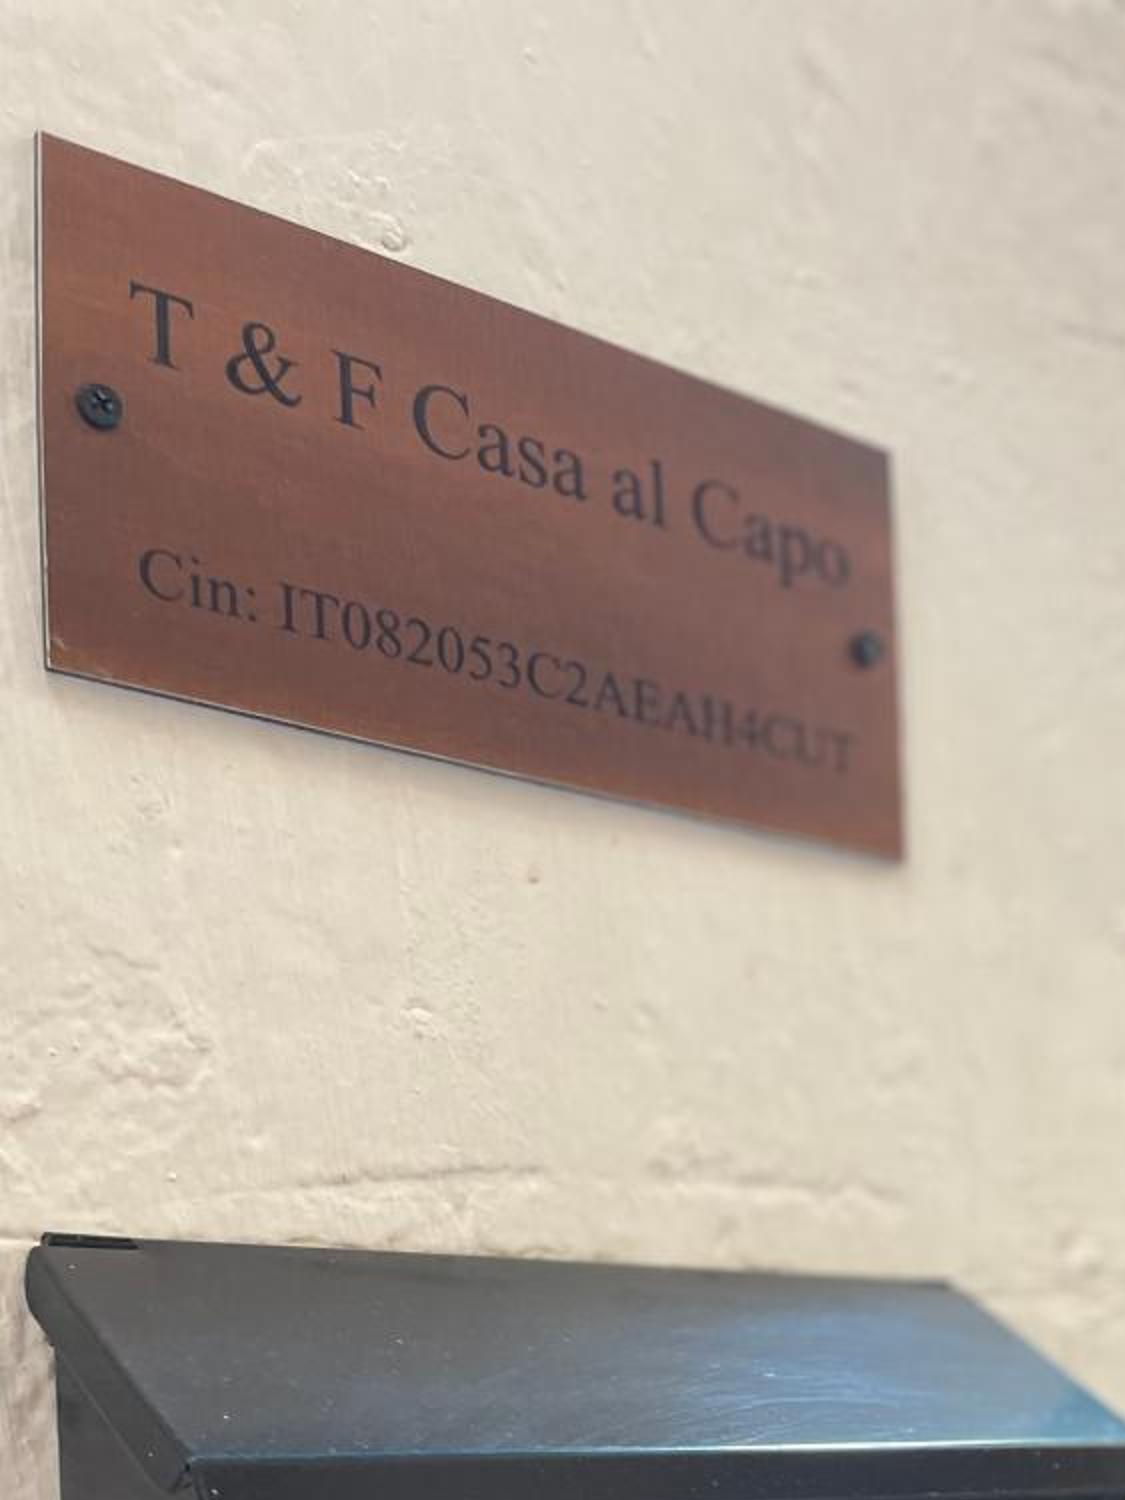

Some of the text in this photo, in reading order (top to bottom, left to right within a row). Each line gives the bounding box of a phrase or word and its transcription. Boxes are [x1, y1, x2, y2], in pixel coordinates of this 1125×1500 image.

[130, 280, 852, 590] T & F Casa al Capo
[138, 547, 258, 623] Cin:
